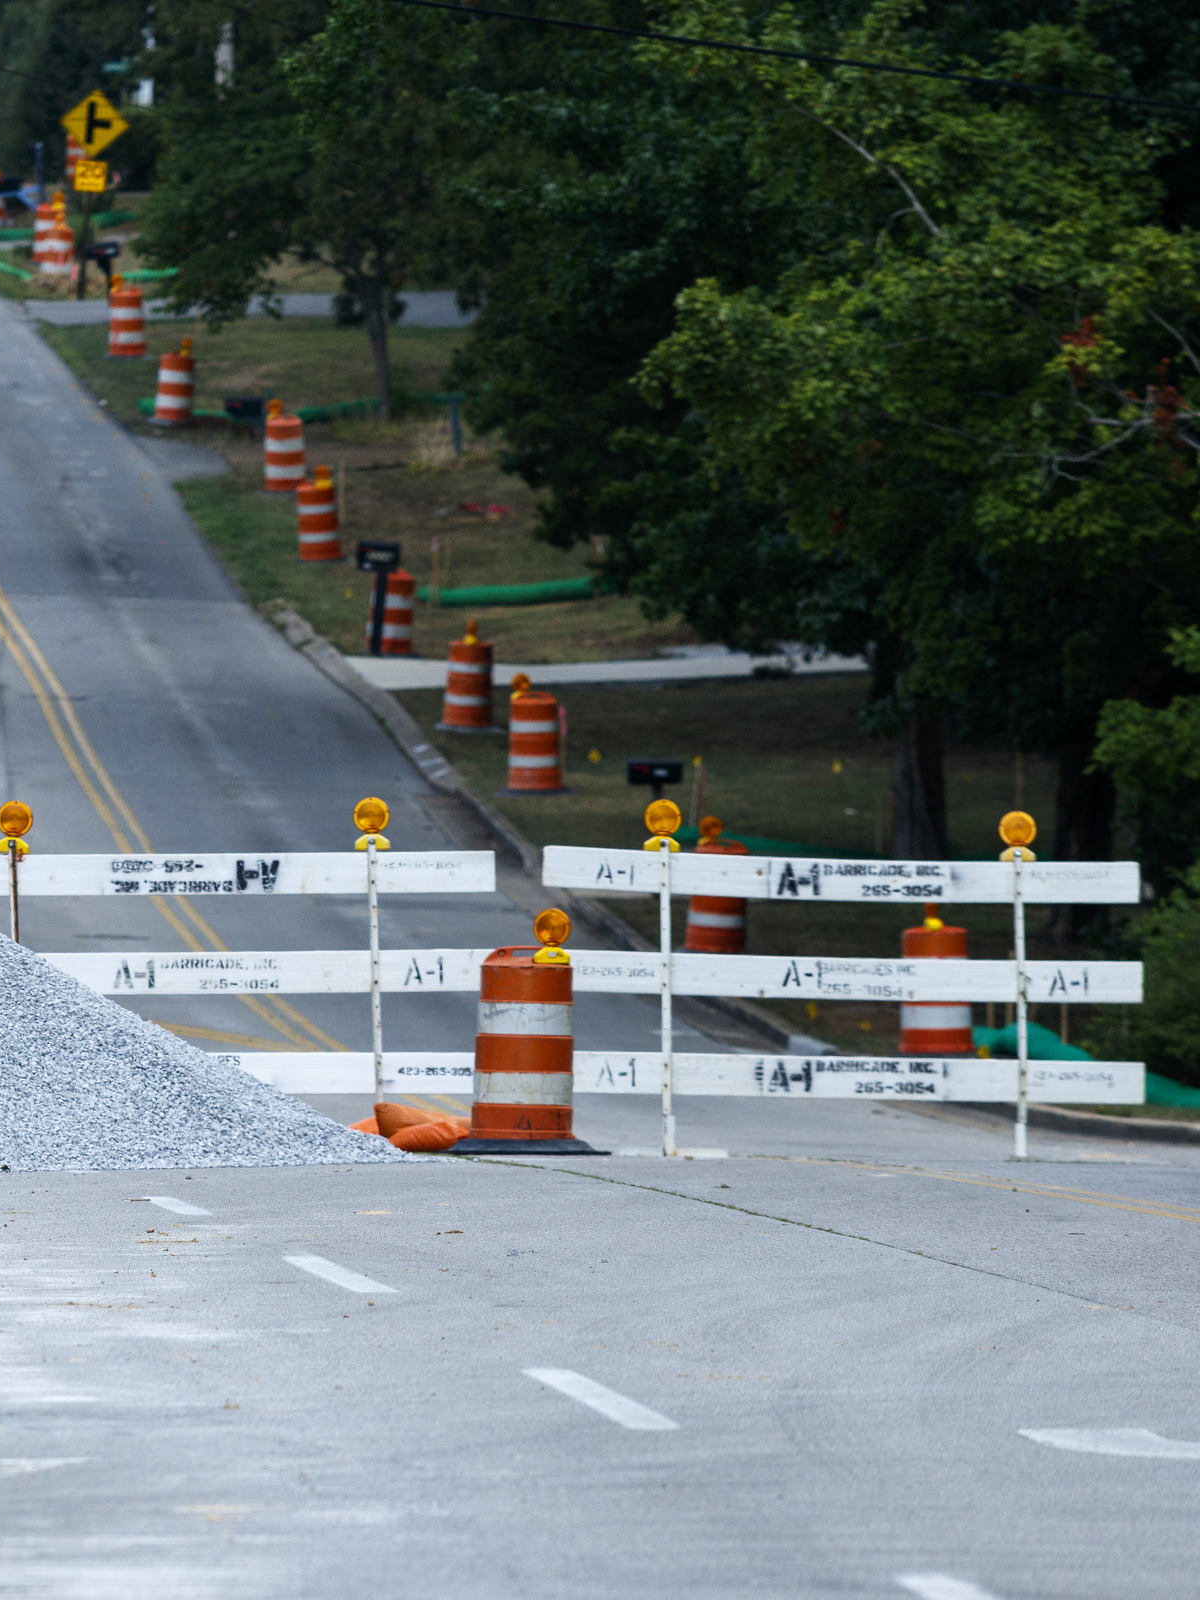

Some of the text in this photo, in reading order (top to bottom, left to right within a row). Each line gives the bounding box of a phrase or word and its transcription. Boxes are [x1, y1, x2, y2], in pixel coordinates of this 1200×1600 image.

[595, 858, 635, 886] A-1
[776, 863, 820, 896] A-1
[823, 864, 910, 878] BARRICADE,
[861, 885, 943, 897] 265-3054
[113, 959, 156, 989] A-1
[404, 956, 444, 986] A-1
[782, 960, 822, 989] A-1
[1048, 968, 1089, 996] A-1
[397, 1066, 473, 1077] 423-265-305
[596, 1058, 636, 1087] A-1
[768, 1059, 811, 1092] A-1
[854, 1081, 936, 1095] 265-3054
